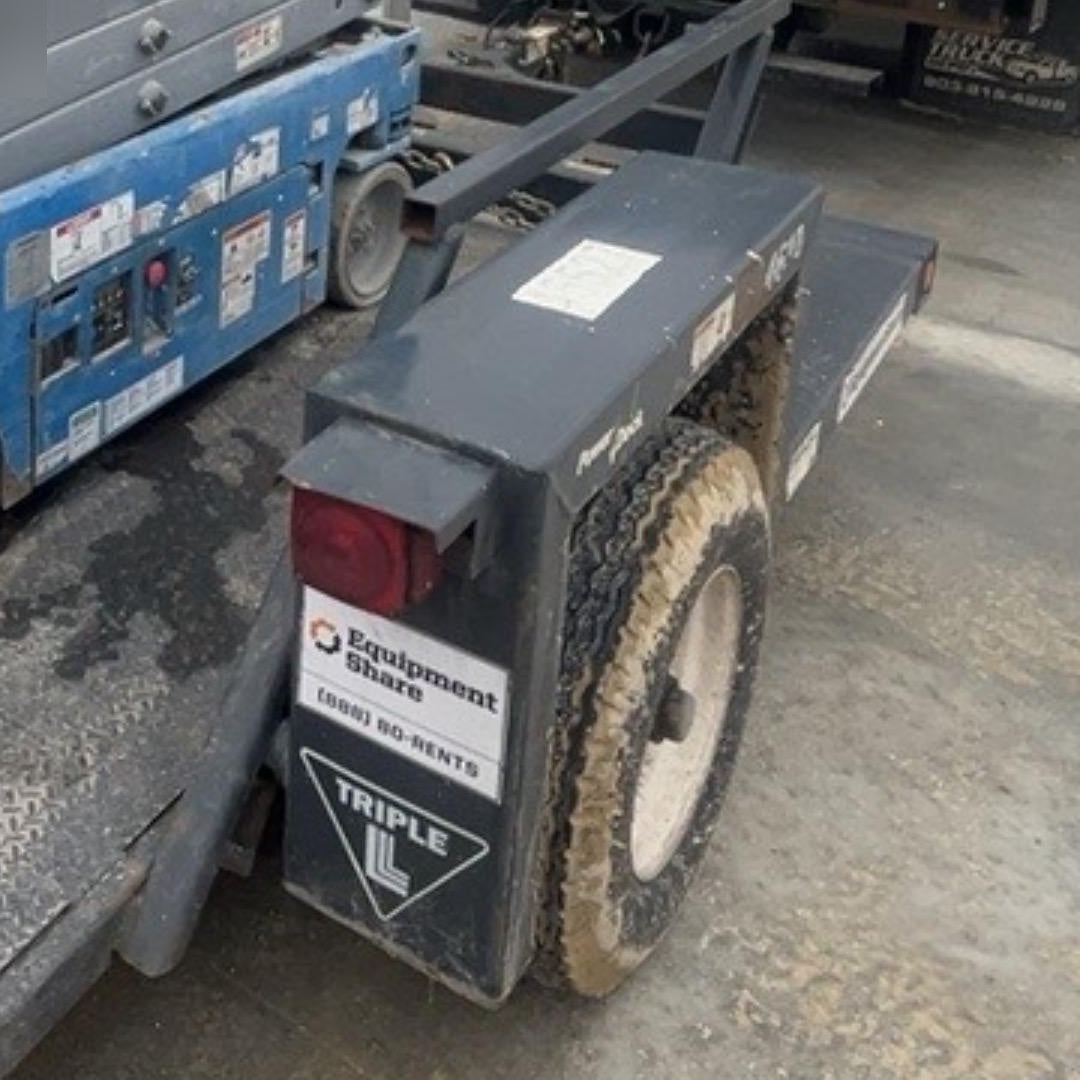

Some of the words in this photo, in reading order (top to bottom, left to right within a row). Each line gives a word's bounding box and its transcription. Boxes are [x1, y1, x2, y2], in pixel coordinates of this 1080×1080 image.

[345, 651, 425, 703] Share
[347, 626, 499, 715] Equipment
[335, 775, 449, 857] TRIPLE
